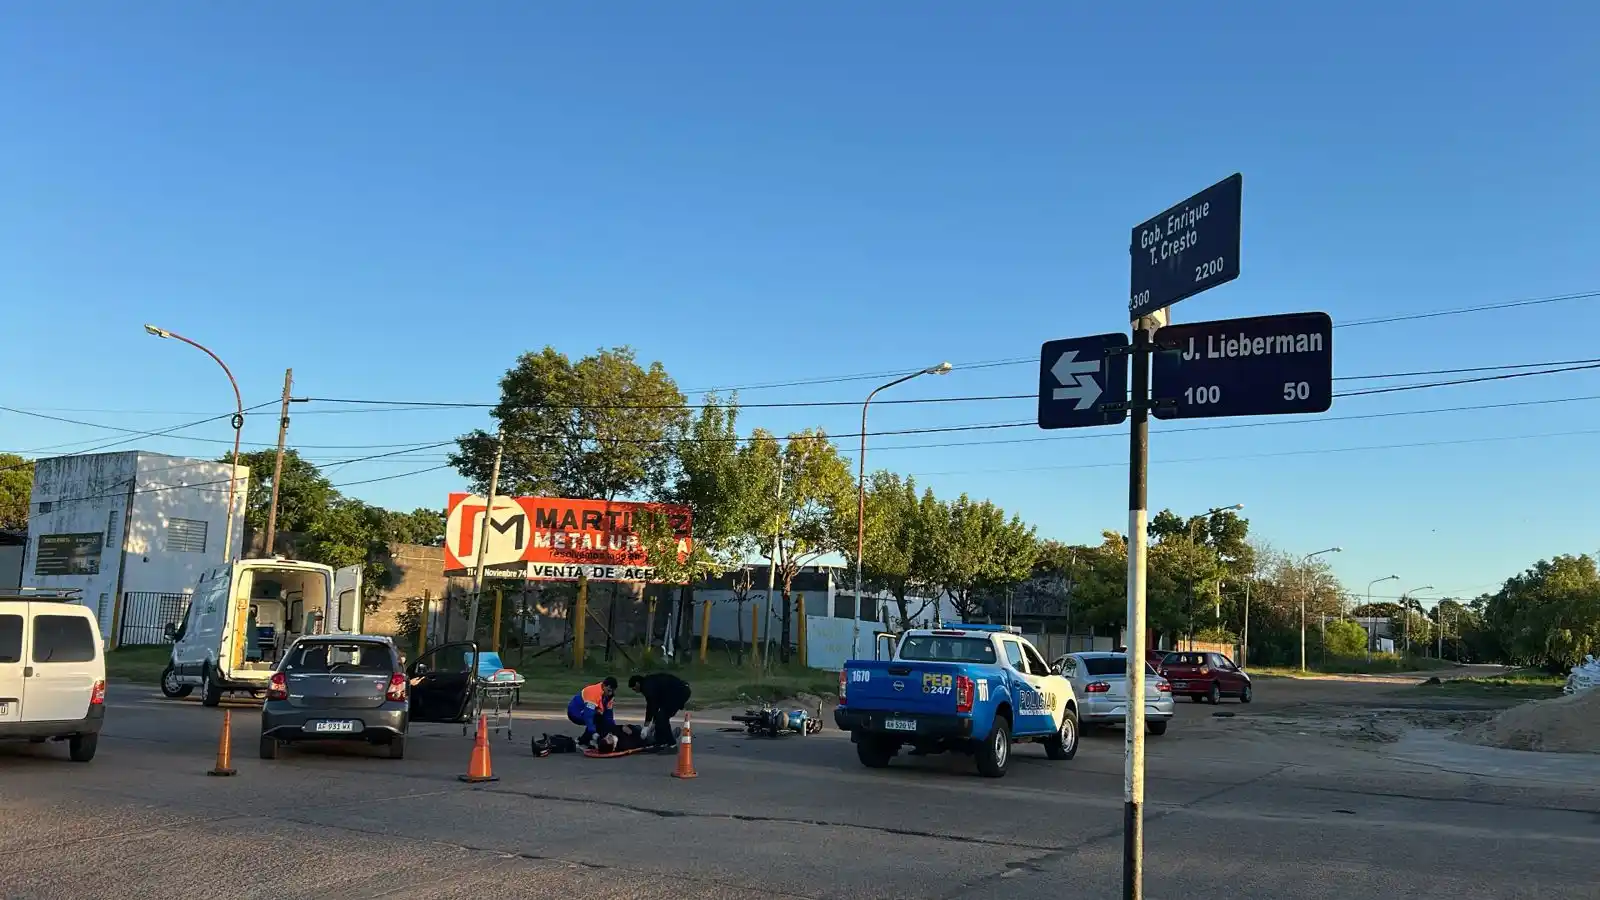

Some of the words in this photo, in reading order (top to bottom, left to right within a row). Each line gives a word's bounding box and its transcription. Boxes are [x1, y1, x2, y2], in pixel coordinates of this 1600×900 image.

[1141, 224, 1164, 249] Gob.
[1167, 202, 1210, 236] Enrique
[1150, 246, 1158, 265] T.
[1161, 230, 1197, 260] Cresto
[1195, 256, 1224, 282] 2200
[1182, 337, 1200, 361] J.
[1207, 332, 1323, 359] Lieberman
[1184, 385, 1221, 405] 100
[1283, 381, 1310, 401] 50
[535, 507, 687, 535] MARTIZ
[484, 569, 517, 578] Noviembre
[533, 565, 584, 578] VENTA
[593, 566, 615, 578] DE
[852, 670, 870, 682] 1670
[923, 673, 952, 687] PER
[930, 686, 952, 695] 24/7
